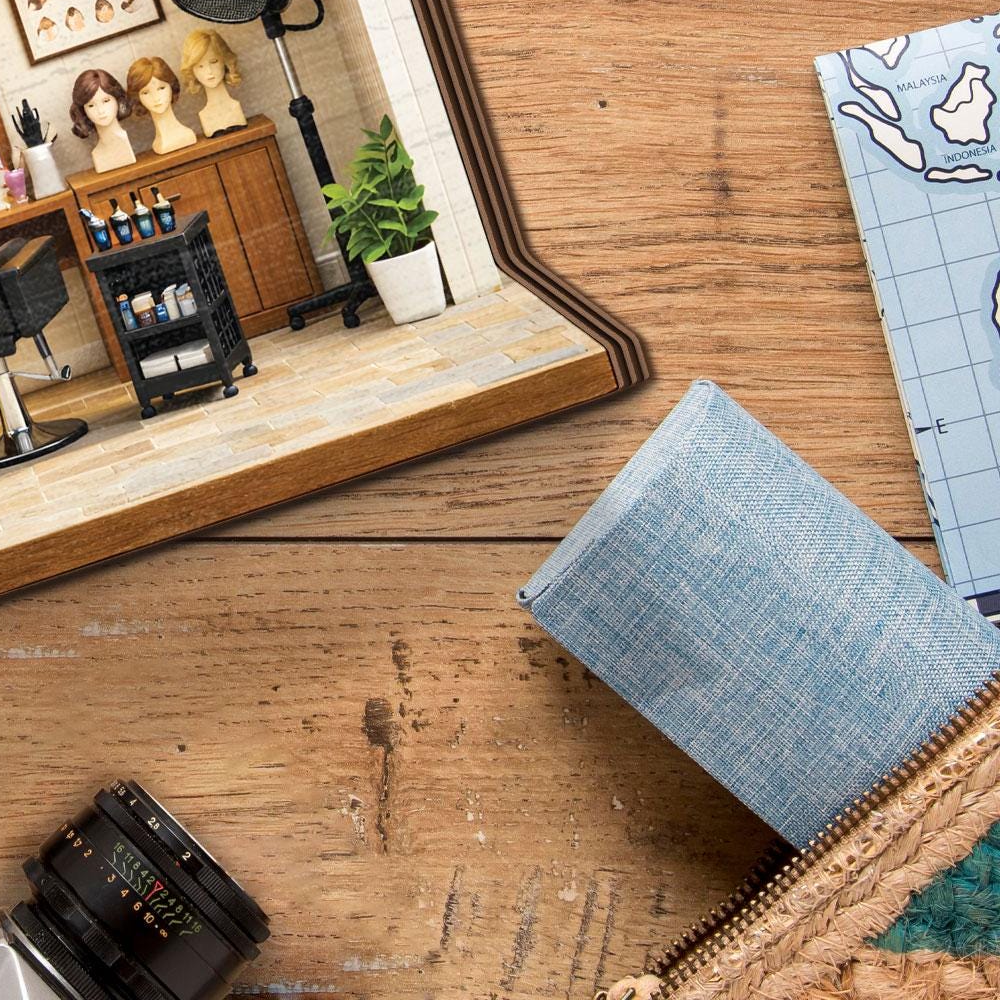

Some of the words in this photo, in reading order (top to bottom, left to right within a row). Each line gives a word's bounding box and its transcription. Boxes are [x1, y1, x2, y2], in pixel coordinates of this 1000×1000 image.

[896, 73, 948, 93] MALAYSIA
[944, 144, 997, 164] INDONESIA
[936, 418, 949, 434] E
[113, 842, 123, 853] 16
[125, 852, 134, 864] 11
[133, 861, 140, 870] 8
[140, 870, 149, 878] 4
[182, 851, 191, 861] 2
[84, 849, 92, 858] 2
[107, 874, 116, 883] 3
[121, 889, 130, 898] 4
[133, 902, 142, 911] 6
[143, 912, 154, 924] 10
[160, 890, 169, 898] 2
[168, 897, 176, 906] 4
[183, 912, 193, 923] 11
[192, 921, 202, 933] 16
